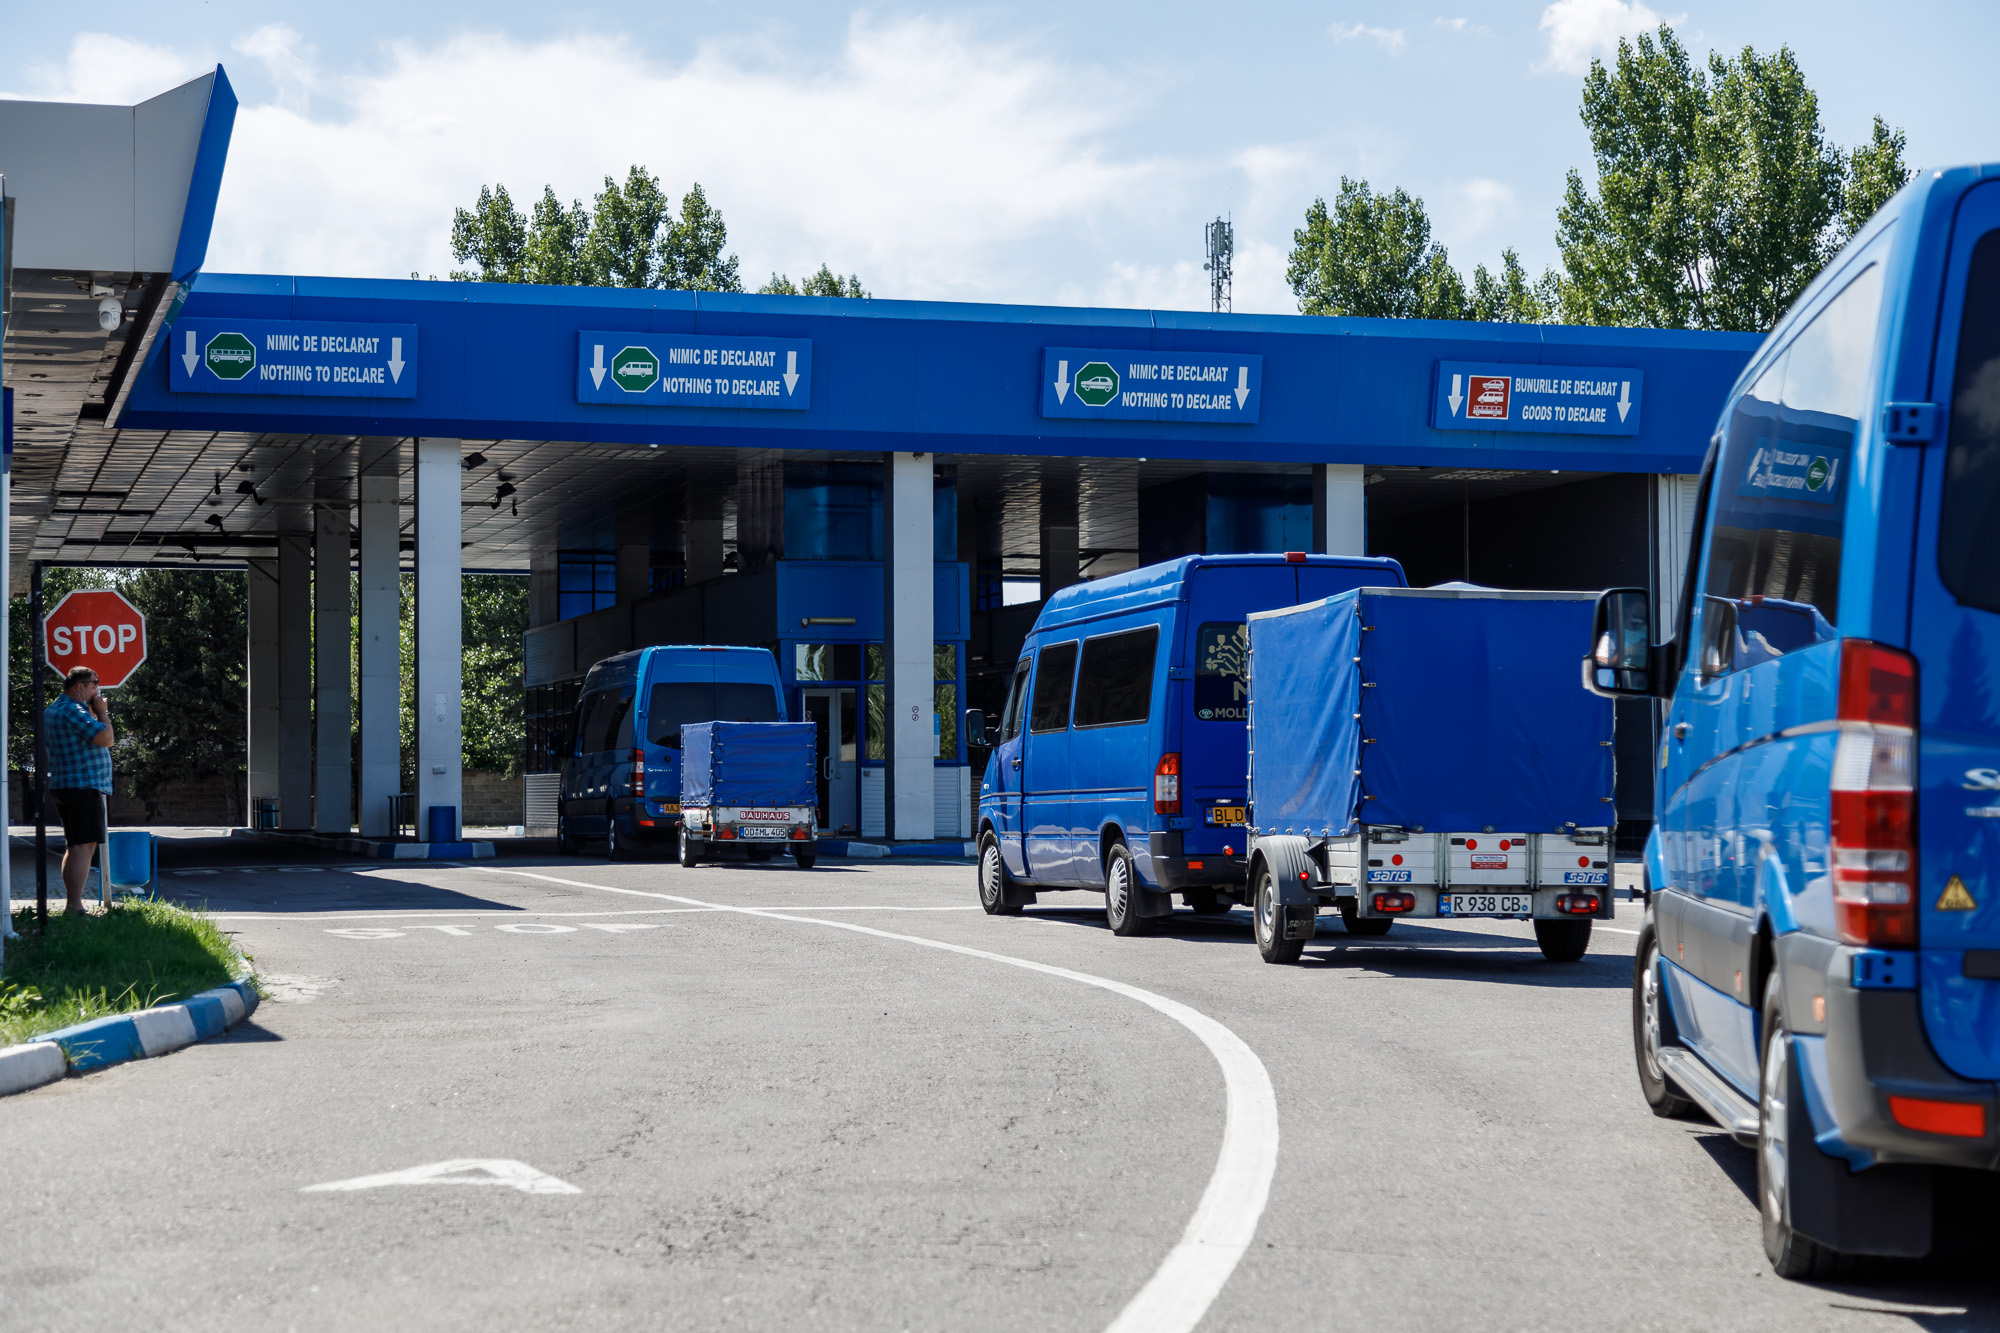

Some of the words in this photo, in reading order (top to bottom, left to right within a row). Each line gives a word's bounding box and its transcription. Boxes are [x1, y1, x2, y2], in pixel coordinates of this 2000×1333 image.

[266, 334, 300, 352] NIMIC
[303, 335, 318, 352] DE
[321, 336, 380, 354] DECLARAT
[669, 348, 700, 365] NIMIC
[703, 349, 718, 366] DE
[720, 349, 776, 367] DECLARAT
[260, 364, 312, 382] NOTHING
[315, 366, 331, 383] TO
[333, 366, 385, 384] DECLARE
[1129, 363, 1159, 380] NIMIC
[1160, 365, 1174, 381] DE
[1176, 366, 1229, 382] DECLARAT
[662, 377, 712, 394] NOTHING
[715, 379, 730, 395] TO
[732, 379, 780, 396] DECLARE
[1515, 377, 1559, 394] BUNURILE
[1560, 380, 1572, 395] DE
[1573, 381, 1618, 396] DECLARAT
[1121, 391, 1168, 408] NOTHING
[1170, 393, 1185, 409] TO
[1186, 394, 1232, 410] DECLARE
[1522, 405, 1552, 421] GOODS
[1554, 407, 1566, 422] TO
[1567, 407, 1607, 423] DECLARE
[53, 623, 137, 656] STOP
[740, 811, 790, 820] BAUHAUS
[744, 828, 755, 836] OD
[759, 828, 769, 836] ML
[771, 828, 785, 836] 405
[1371, 871, 1408, 881] saris
[1568, 873, 1604, 883] saris
[1453, 896, 1464, 912] R
[1468, 896, 1496, 912] 938
[1501, 896, 1521, 912] CB
